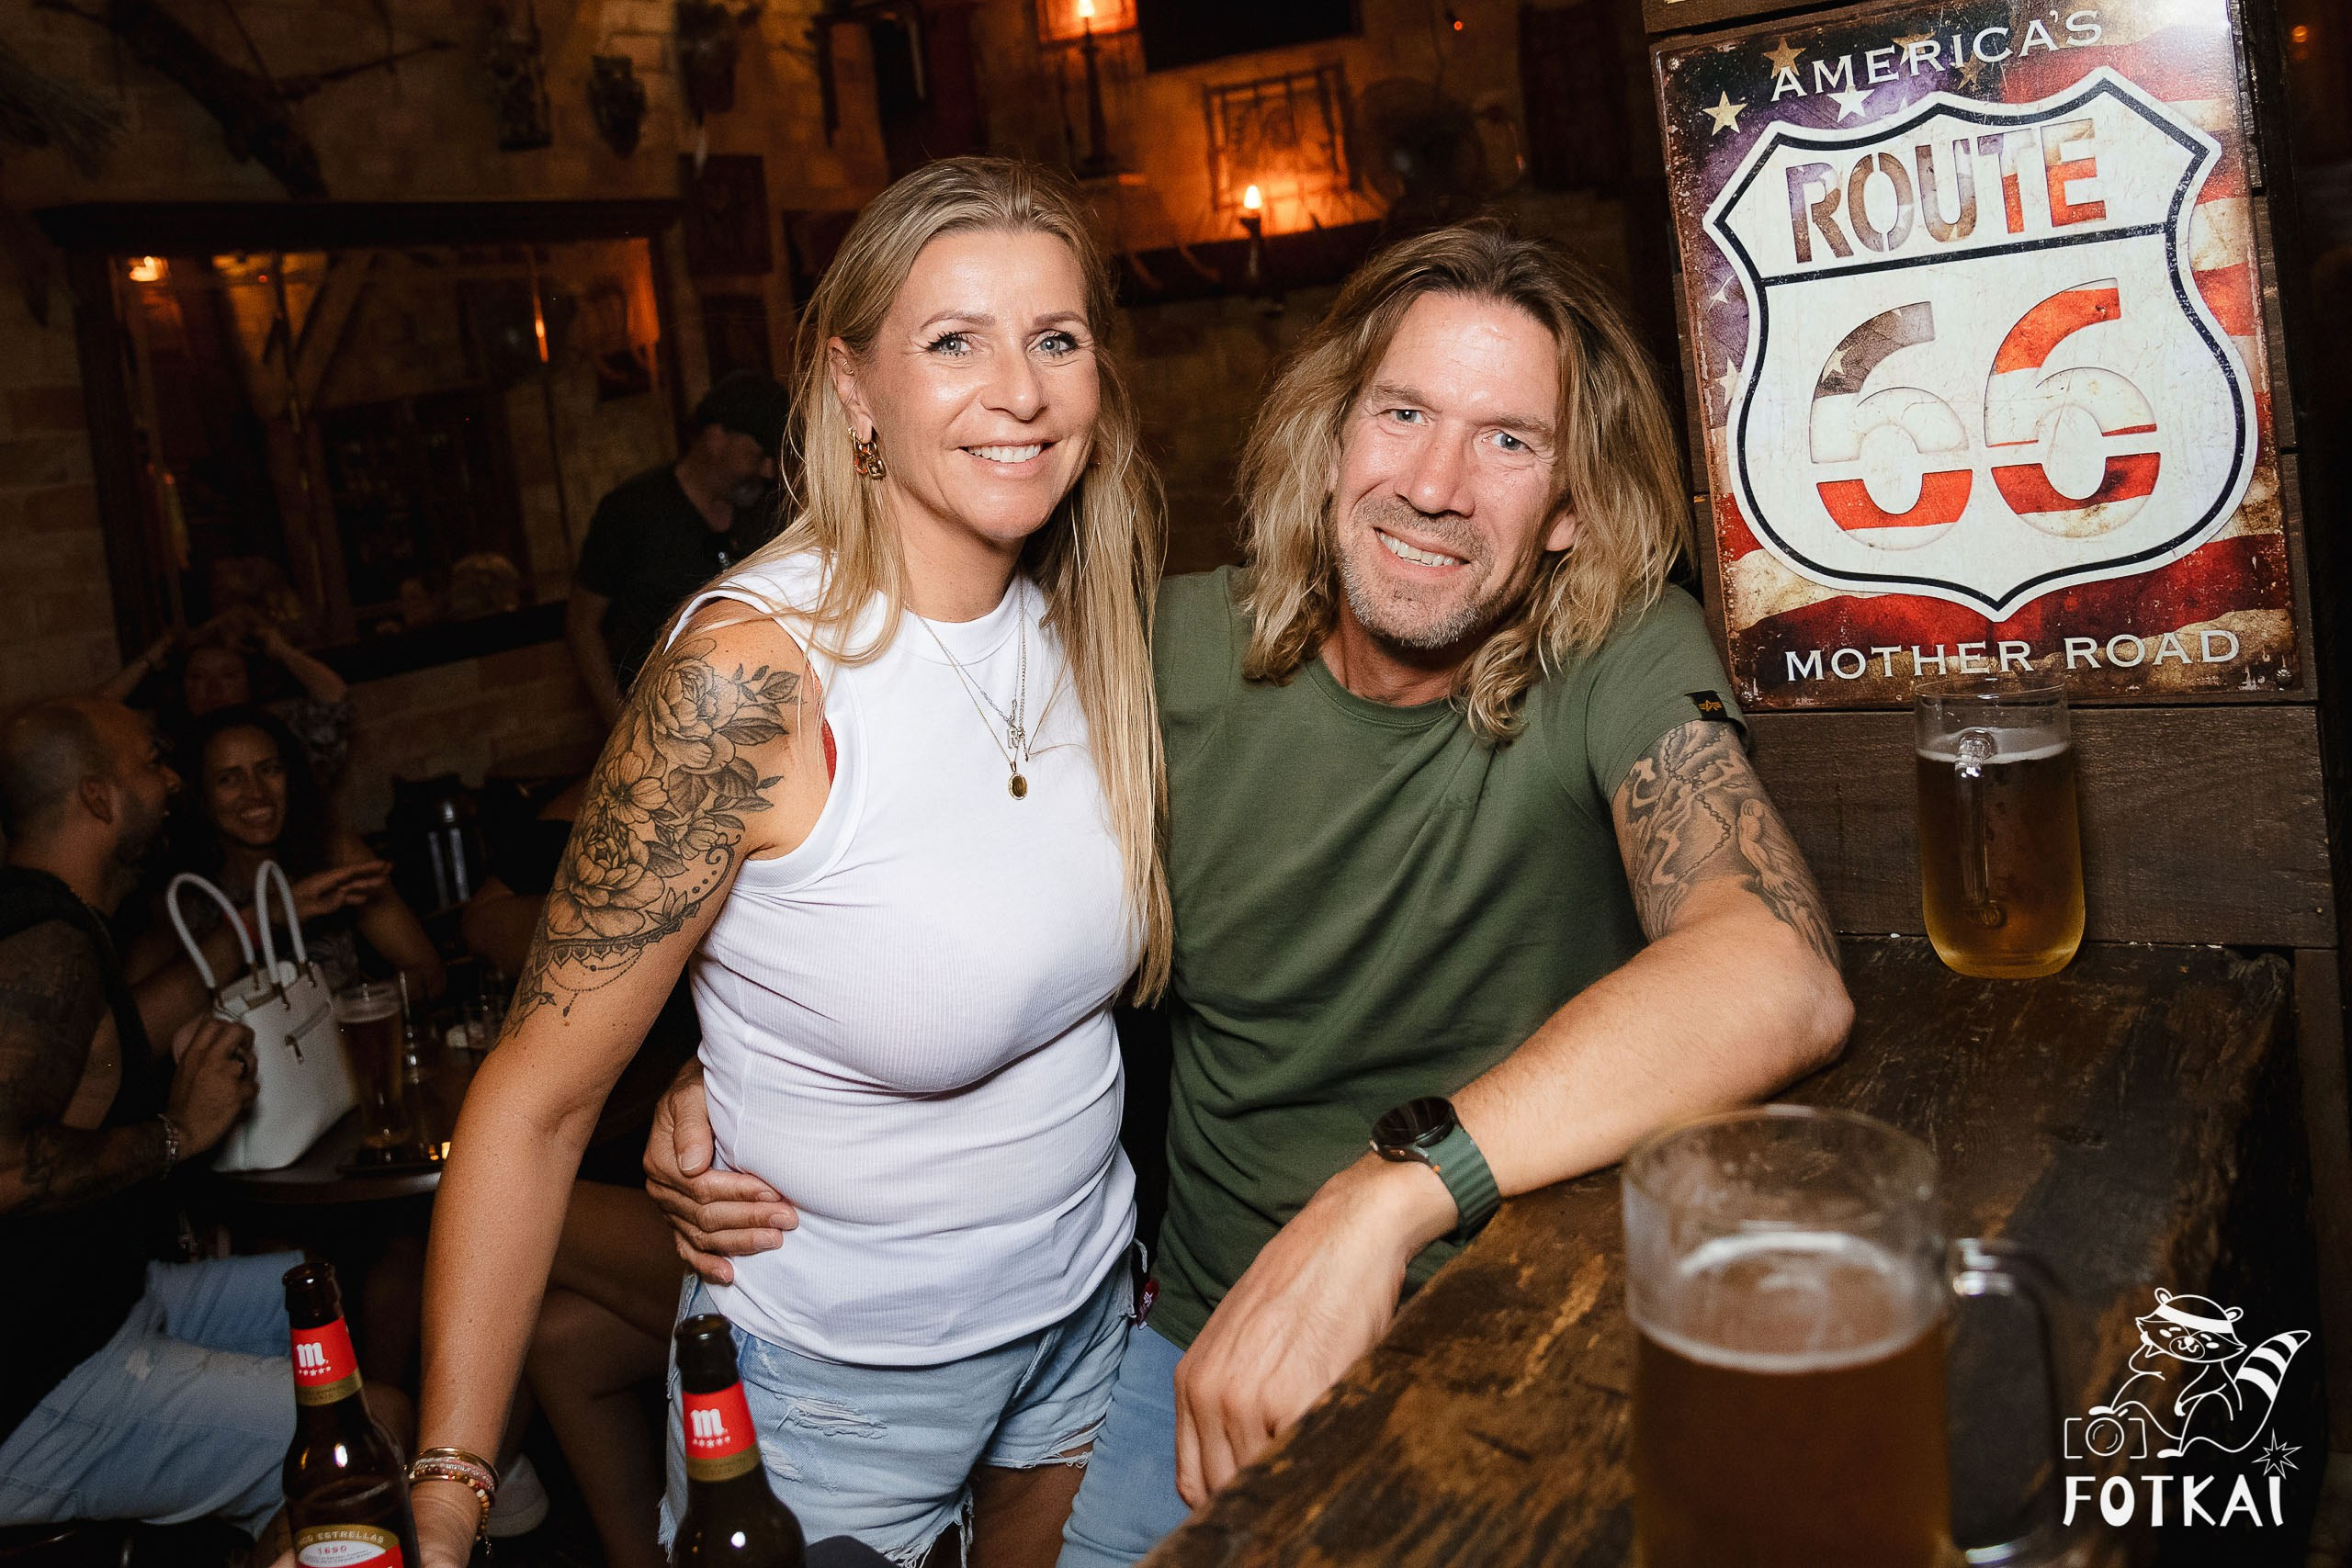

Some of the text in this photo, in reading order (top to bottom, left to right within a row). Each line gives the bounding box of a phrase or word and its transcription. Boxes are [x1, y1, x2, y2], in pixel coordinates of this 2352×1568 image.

[1770, 10, 2103, 102] AMERICA'S
[1786, 118, 2107, 264] ROUTE
[1809, 277, 2161, 550] 66
[1784, 630, 2240, 681] MOTHER ROAD
[317, 1530, 385, 1544] ESTRELLAS
